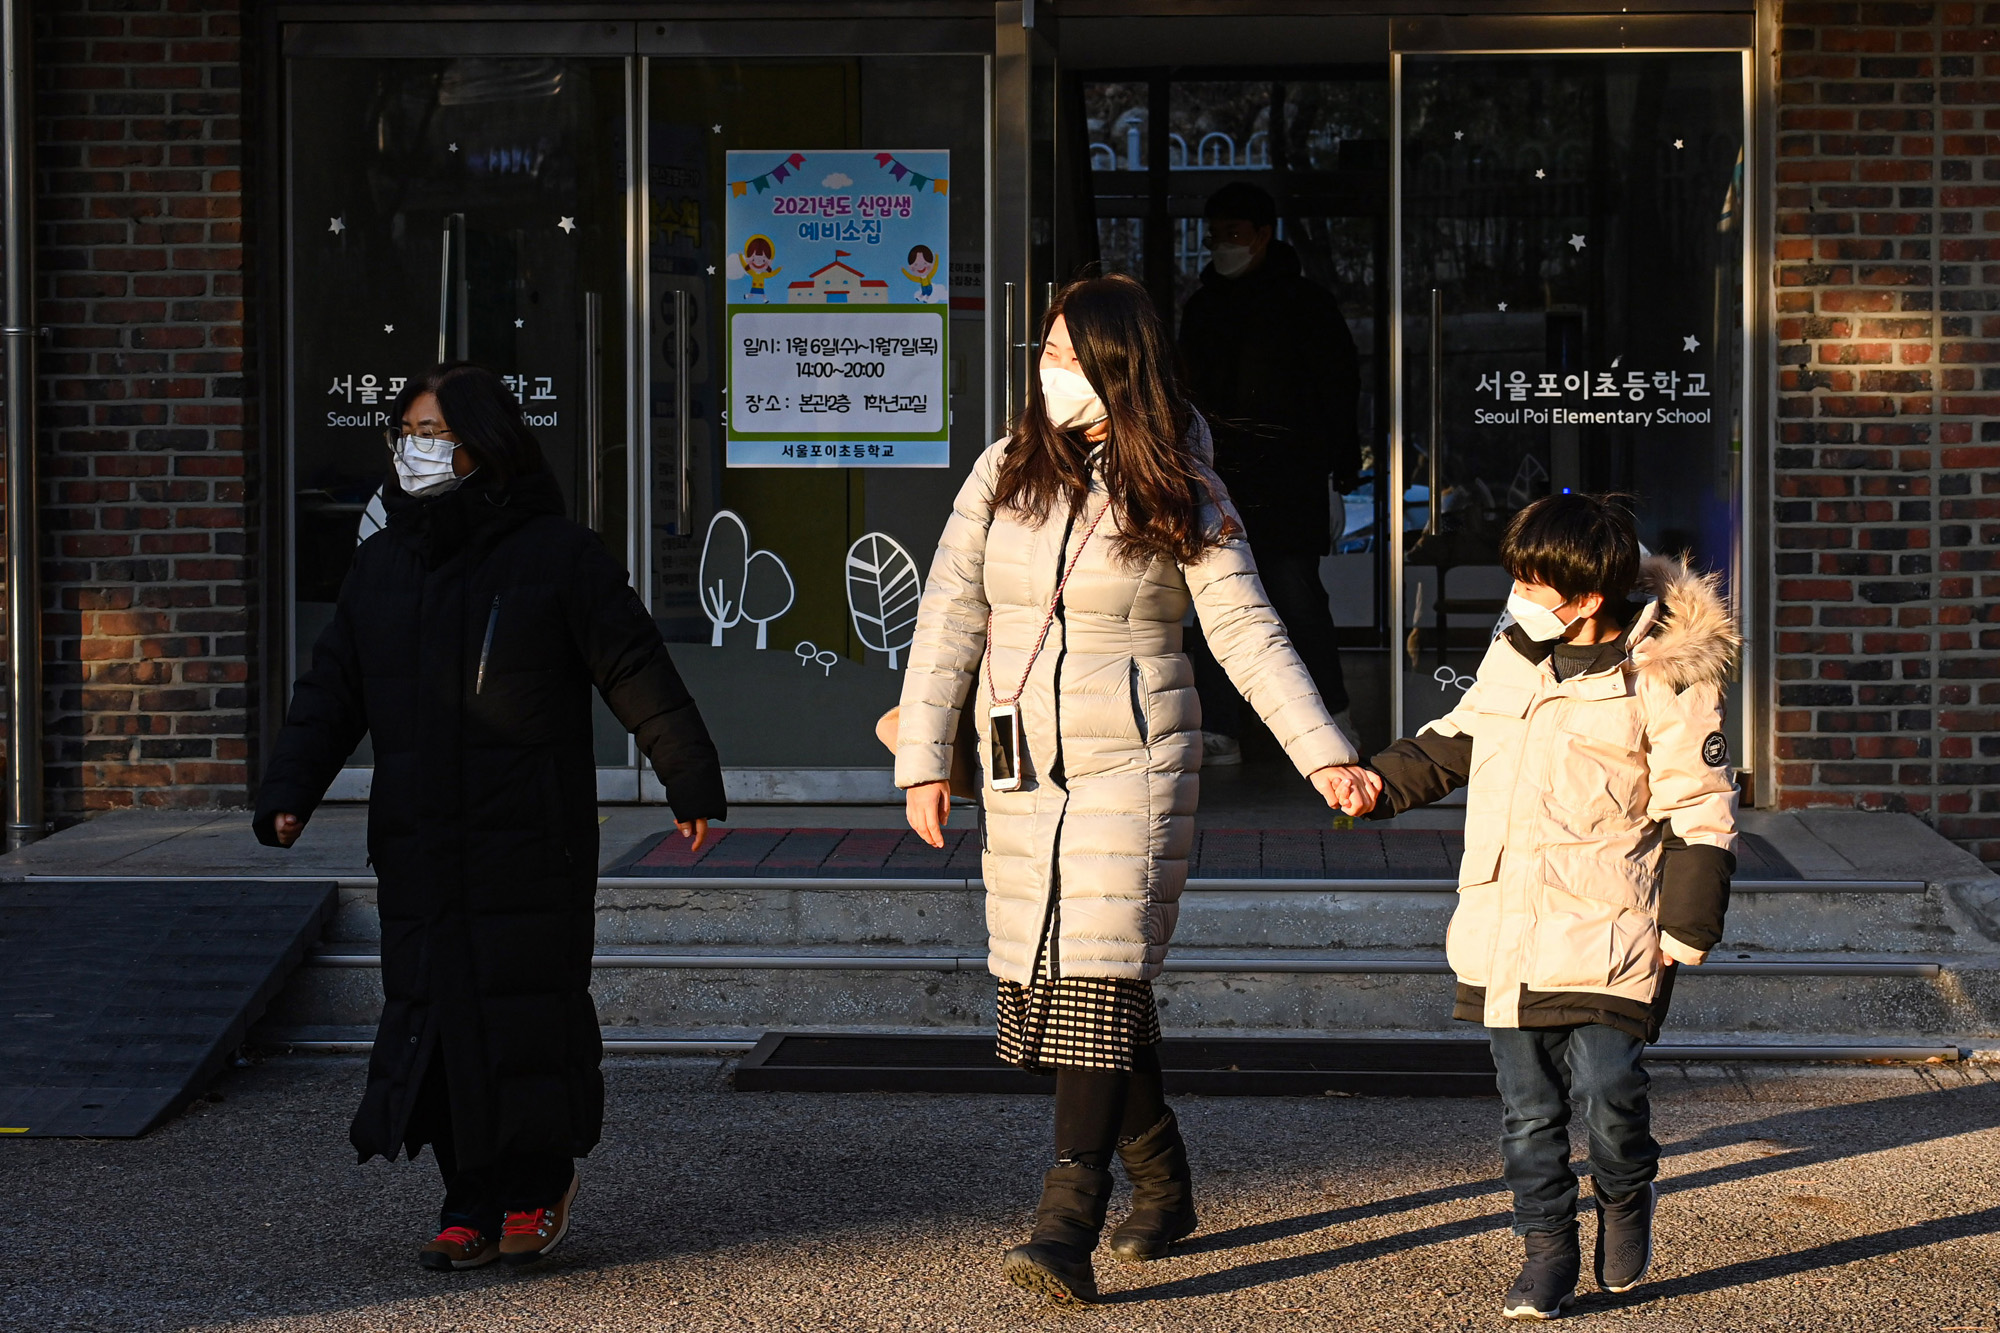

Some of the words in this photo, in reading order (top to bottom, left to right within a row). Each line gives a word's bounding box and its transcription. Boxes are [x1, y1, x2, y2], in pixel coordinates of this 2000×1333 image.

[773, 197, 851, 217] 2021년도
[857, 196, 912, 218] 신입생
[798, 219, 882, 245] 예비소집
[796, 362, 885, 378] 14:00~20:00
[1475, 370, 1711, 402] 서울포이초등학교
[798, 393, 852, 413] 본관2층
[864, 393, 927, 413] 1학년교실
[327, 411, 371, 427] Seoul
[1474, 408, 1519, 424] Seoul
[1523, 408, 1549, 424] Poi
[1553, 408, 1653, 427] Elementary
[1656, 407, 1711, 424] School
[781, 444, 896, 458] 서울포이초등학교
